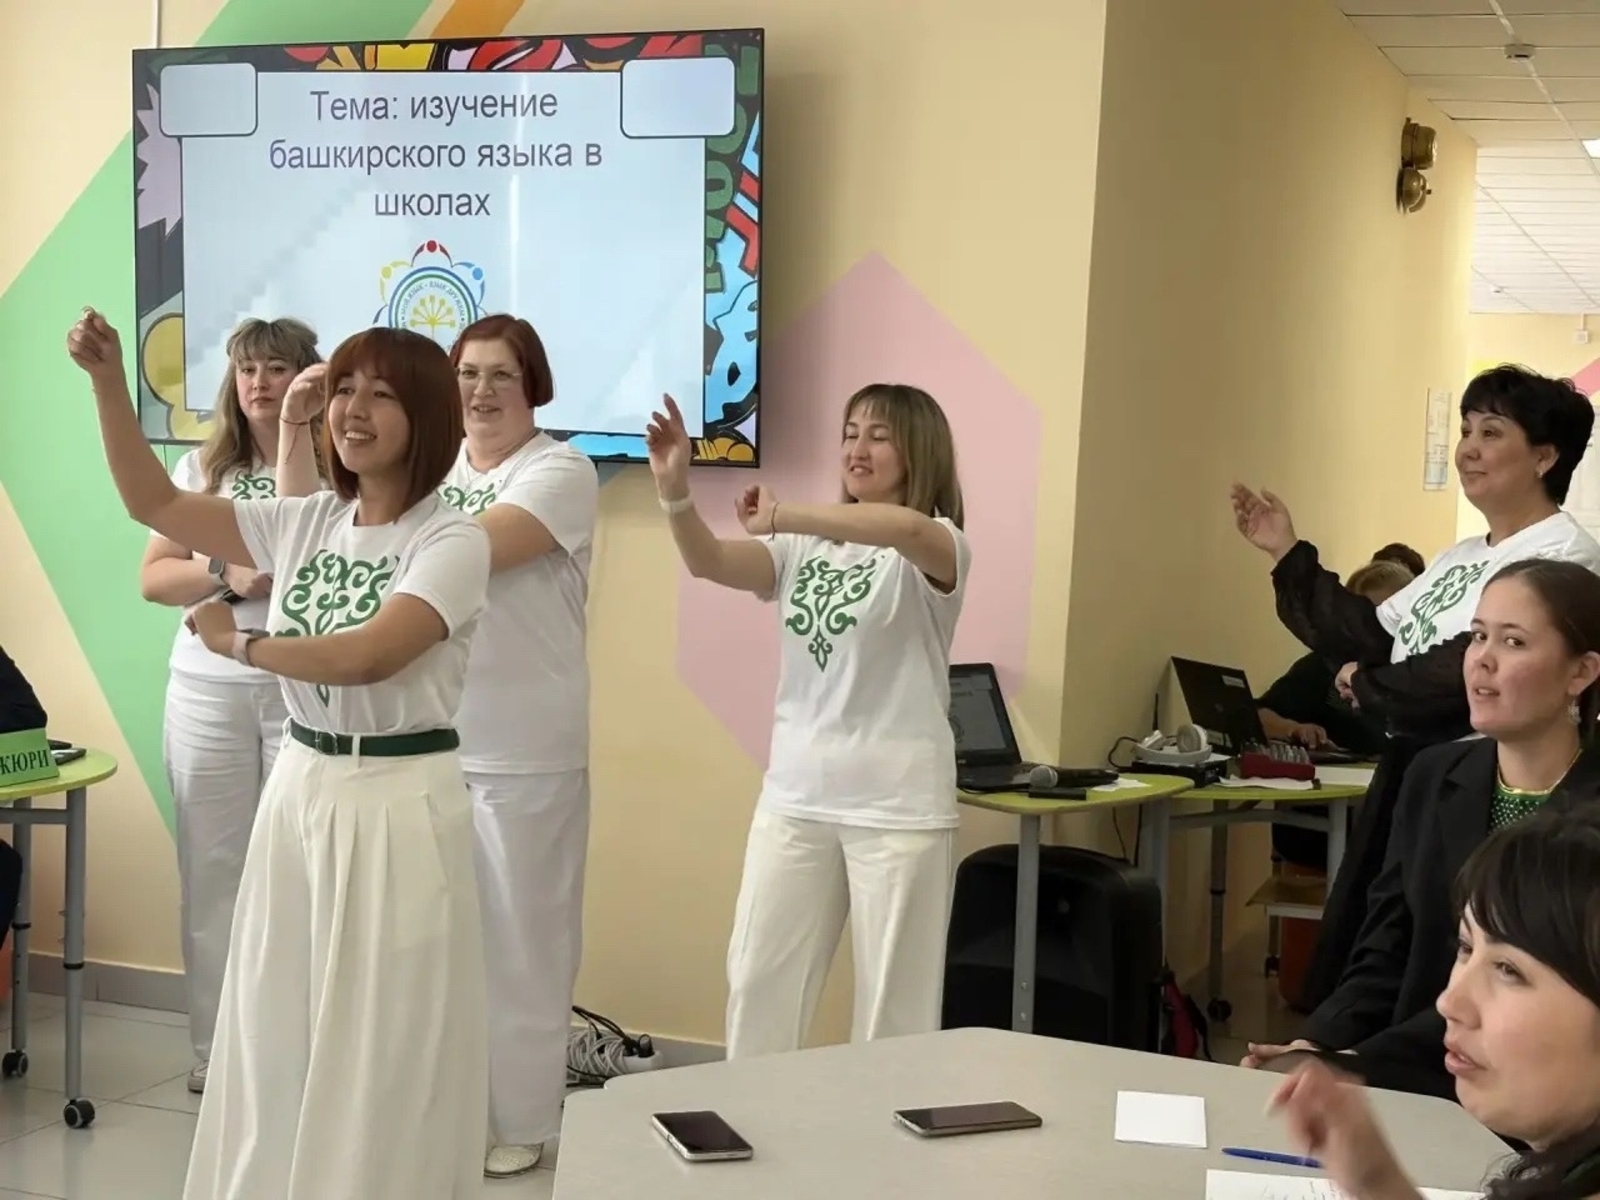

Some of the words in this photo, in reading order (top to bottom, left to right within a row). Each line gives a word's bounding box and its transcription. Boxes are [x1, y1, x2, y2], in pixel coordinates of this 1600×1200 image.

[310, 90, 398, 121] Тема:
[410, 93, 558, 127] изучение
[269, 139, 466, 175] башкирского
[477, 143, 573, 167] языка
[585, 143, 602, 166] в
[375, 193, 491, 217] школах
